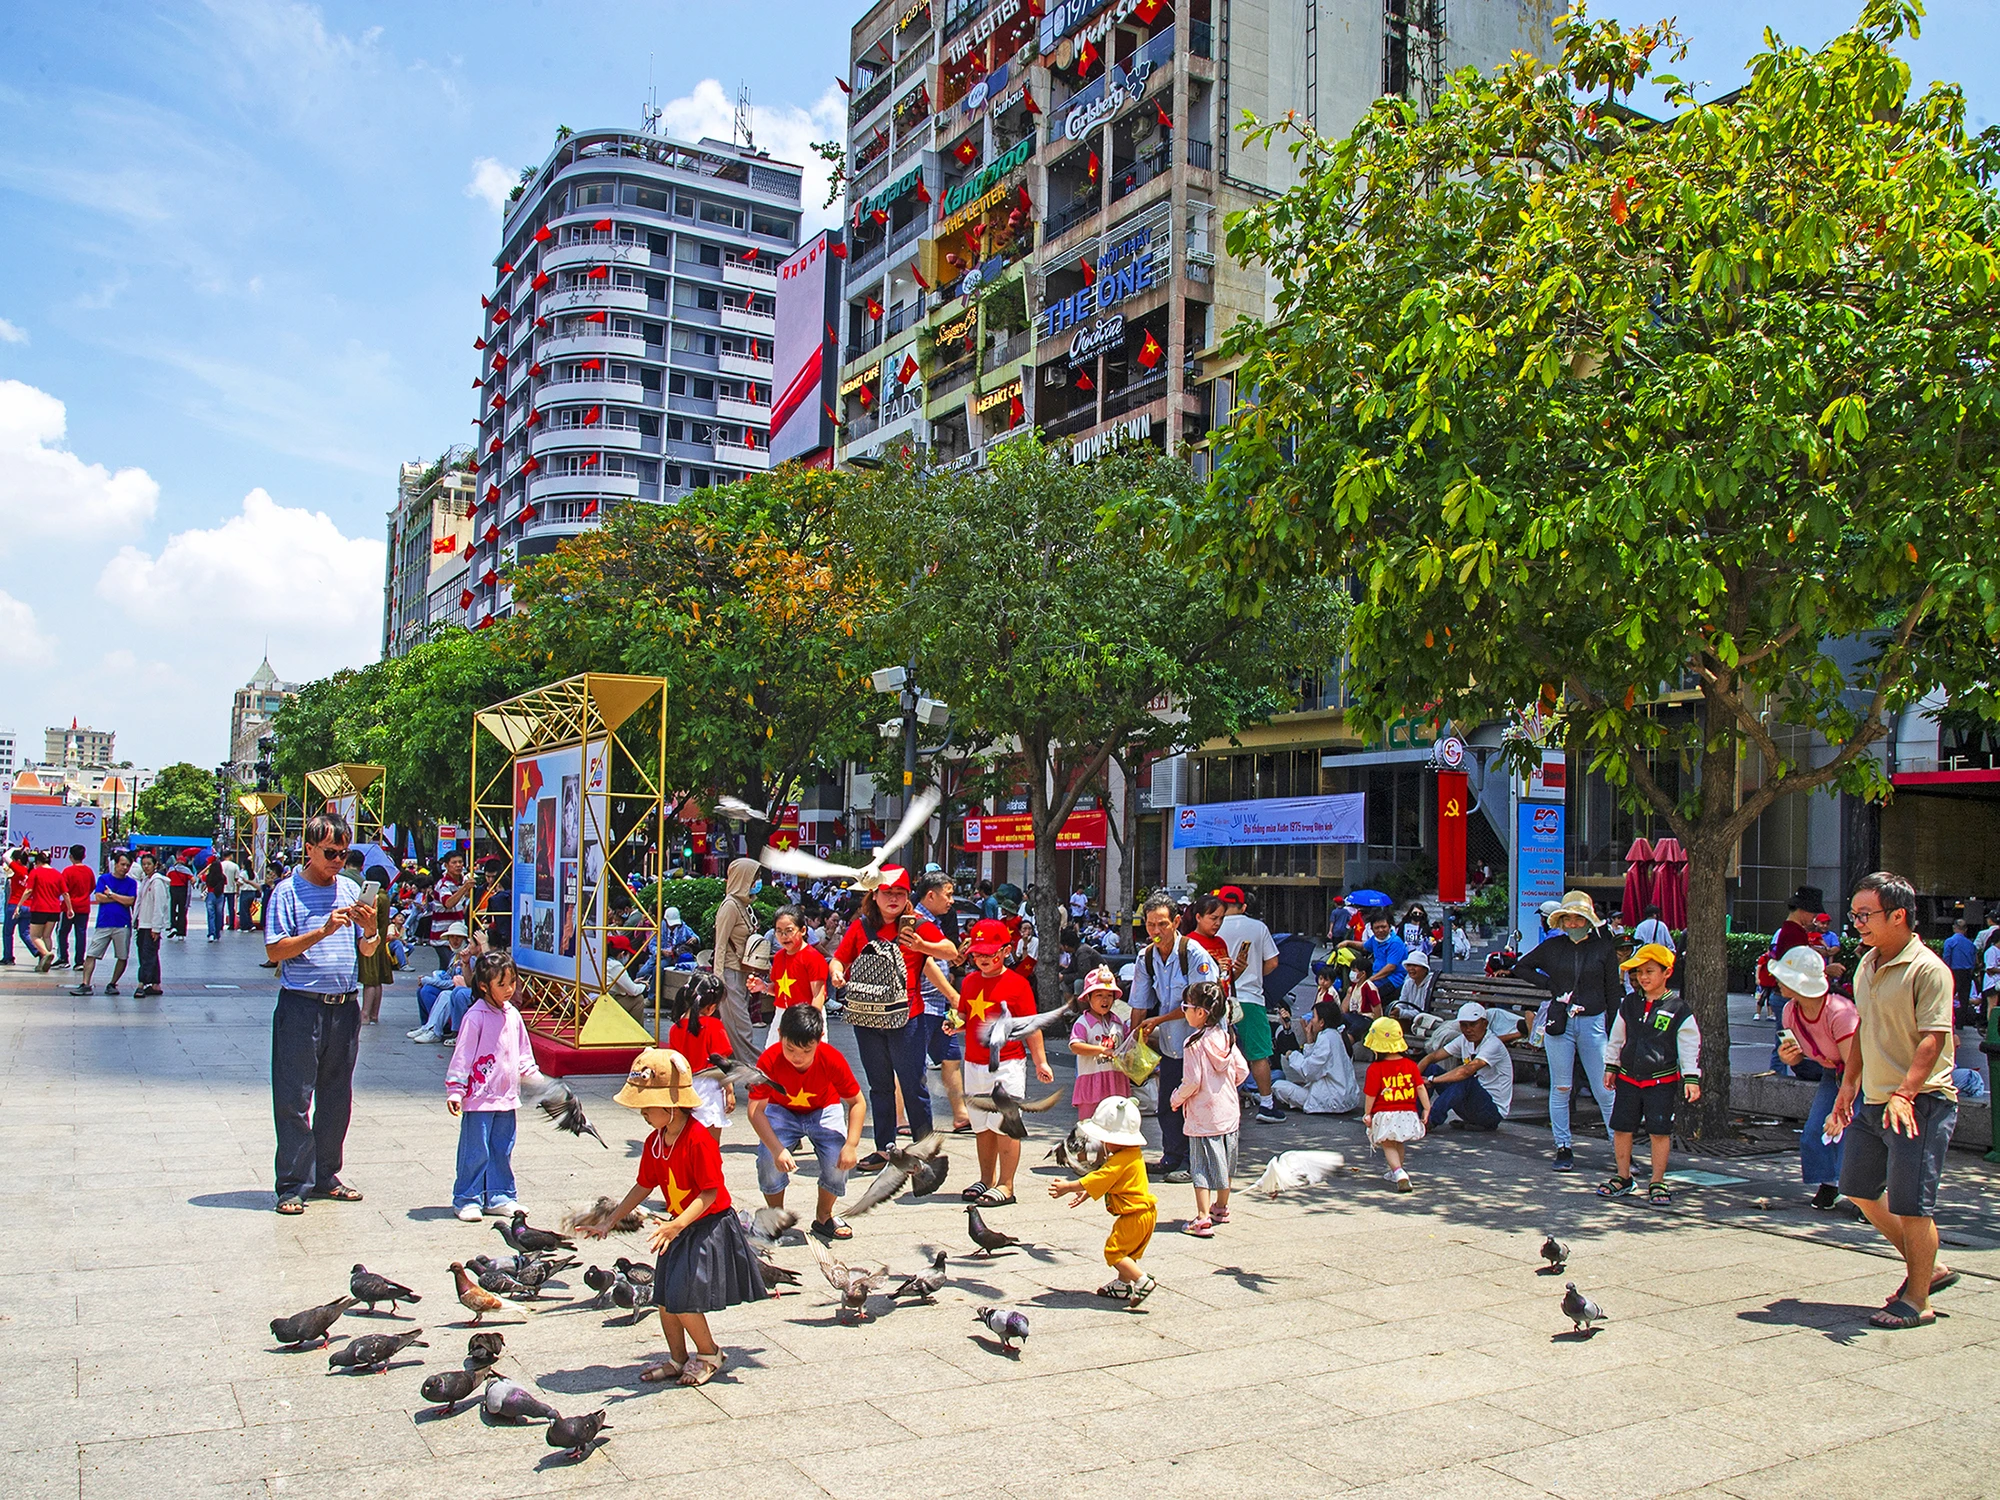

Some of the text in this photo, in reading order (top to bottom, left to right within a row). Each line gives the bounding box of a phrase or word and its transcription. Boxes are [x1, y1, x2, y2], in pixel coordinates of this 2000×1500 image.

[974, 0, 1020, 43] LETTER
[1065, 82, 1124, 140] Carlsberg
[854, 165, 923, 230] Kangaroo
[938, 140, 1029, 220] Kangaroo
[944, 183, 1006, 236] THE LETTER
[1044, 252, 1155, 337] THE ONE
[883, 386, 924, 427] FADO
[976, 387, 1008, 415] MERAKI
[1290, 821, 1301, 832] 1975
[50, 846, 69, 859] 197
[1382, 1072, 1414, 1089] VIỆT
[1383, 1087, 1415, 1101] NAM
